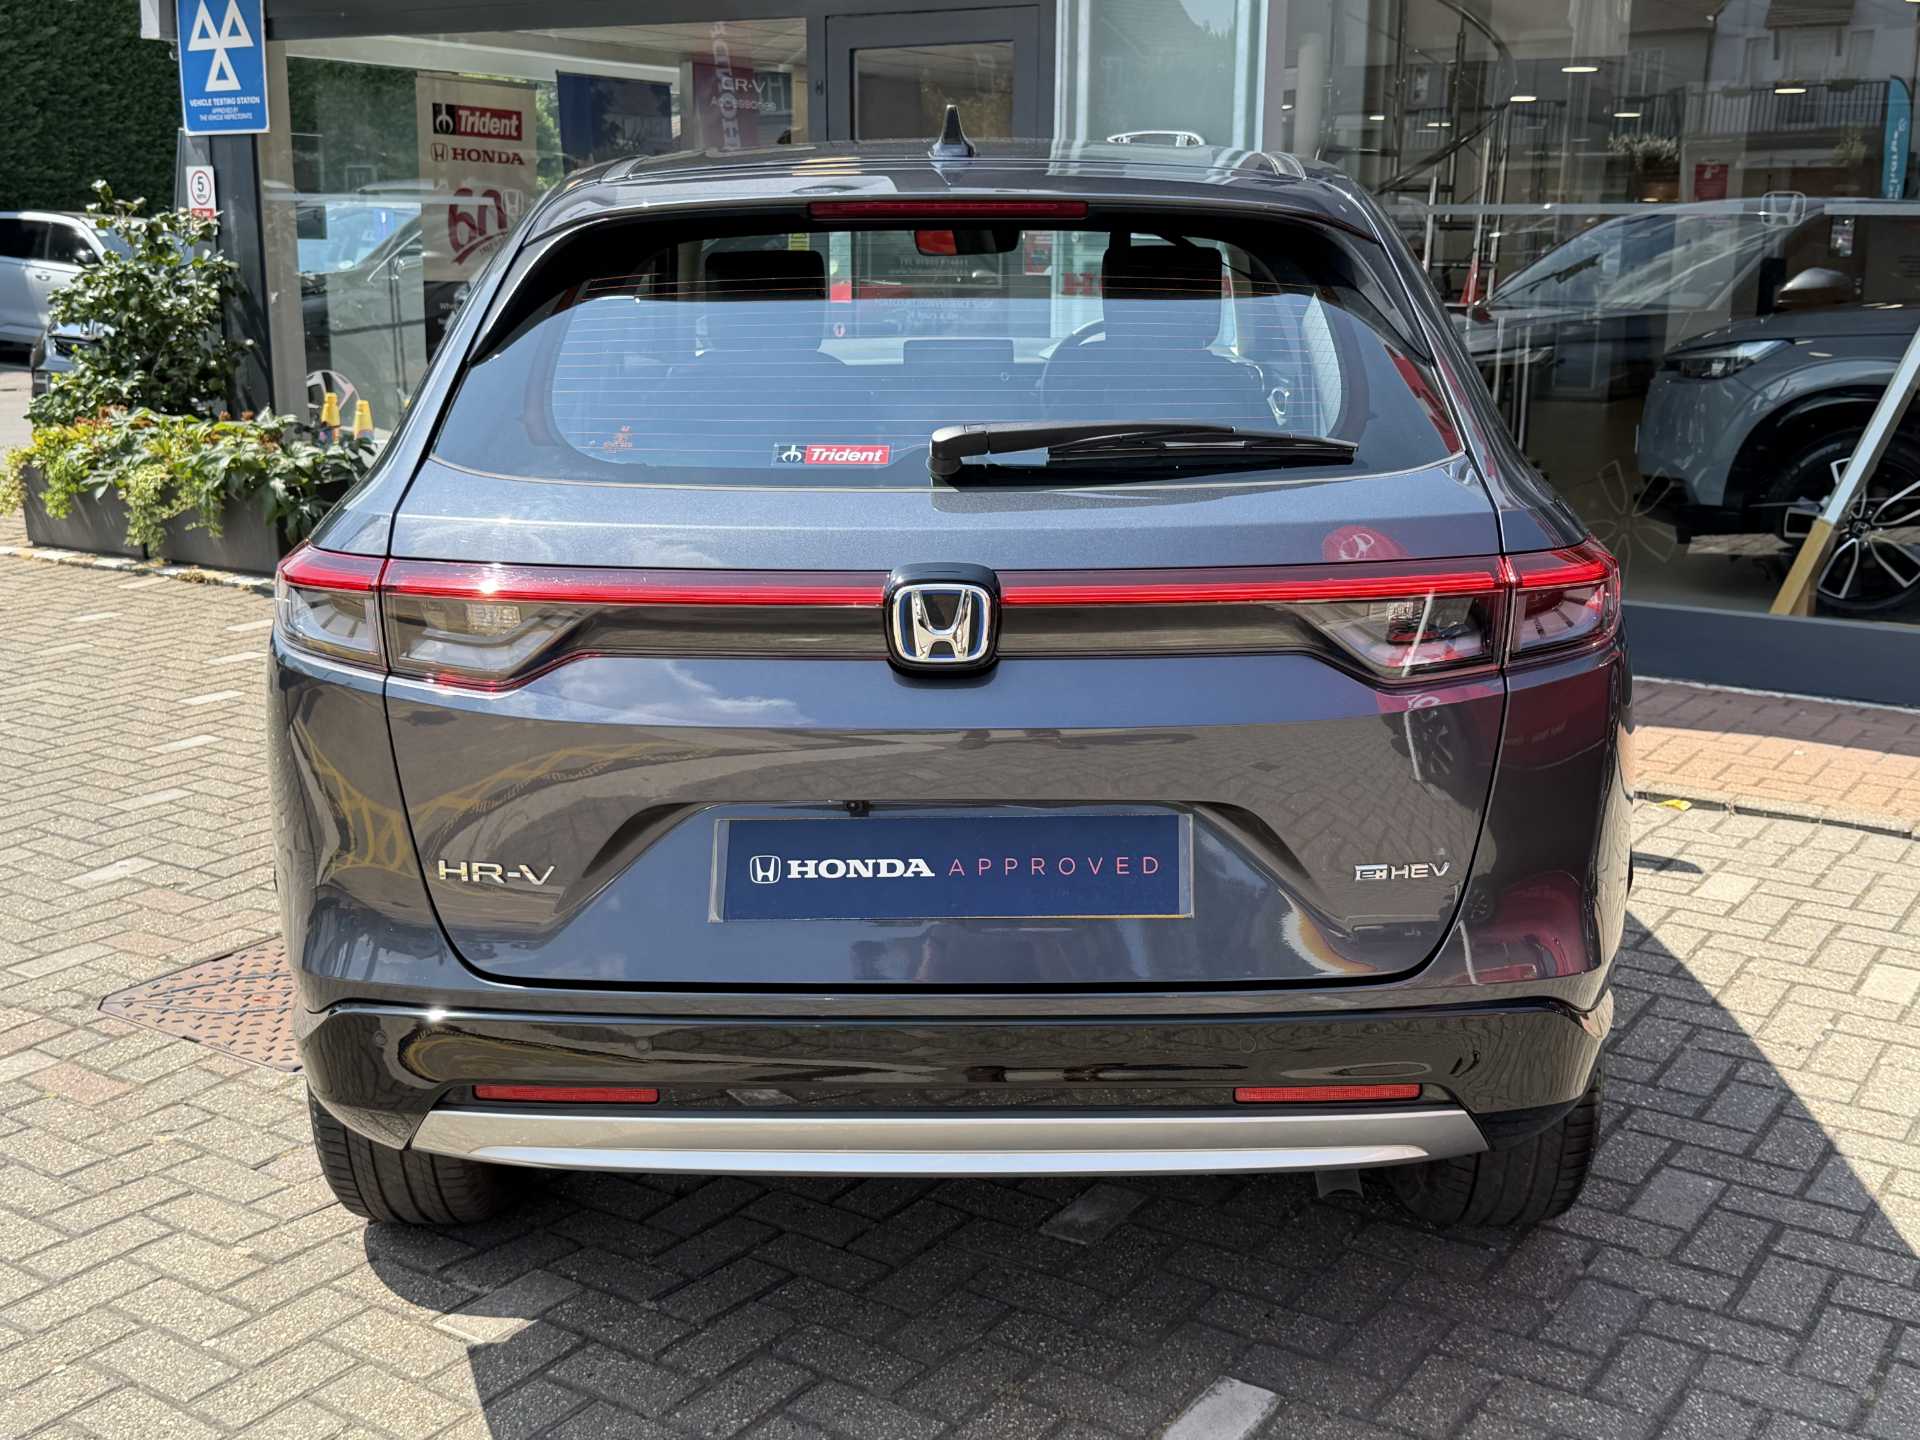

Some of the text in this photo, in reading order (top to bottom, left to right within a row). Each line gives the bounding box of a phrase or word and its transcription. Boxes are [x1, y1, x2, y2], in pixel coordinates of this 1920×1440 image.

[189, 96, 260, 107] VEHICLE TESTING STATION
[458, 109, 519, 137] Trident
[451, 147, 525, 166] HONDA
[197, 176, 204, 192] 5
[811, 448, 884, 462] Trident
[438, 860, 555, 885] HR-V
[787, 858, 935, 880] HONDA
[948, 855, 1159, 877] APPROVED
